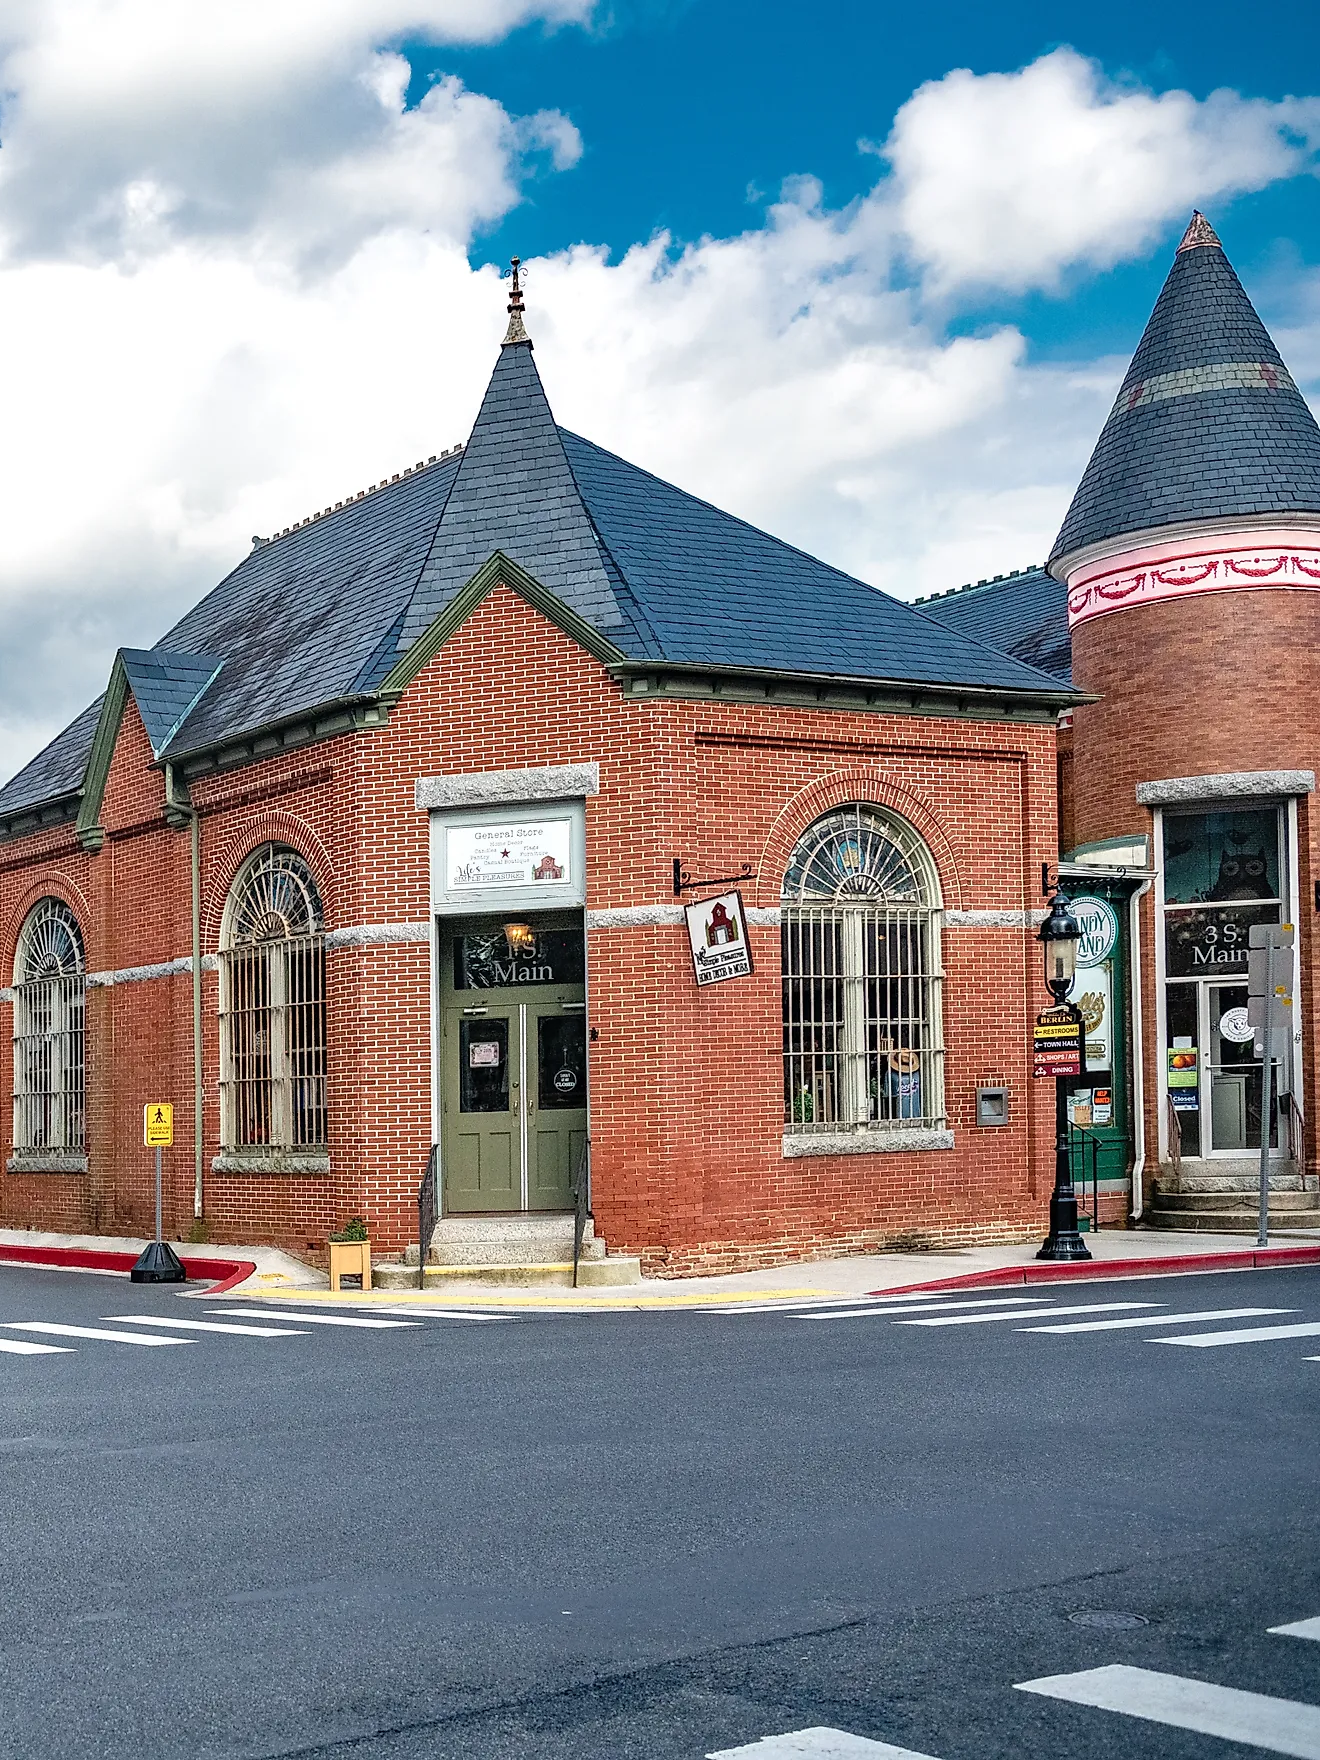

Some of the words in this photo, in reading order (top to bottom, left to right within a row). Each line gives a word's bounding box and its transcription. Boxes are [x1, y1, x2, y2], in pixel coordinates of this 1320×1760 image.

[474, 830, 514, 840] General
[516, 828, 544, 838] Store
[454, 874, 481, 882] SIMPLE
[483, 872, 525, 881] PLEASURES
[1205, 926, 1218, 944] 3
[1223, 924, 1242, 943] S.
[523, 938, 542, 959] S.
[1078, 936, 1104, 957] AND
[1192, 945, 1249, 965] Main
[493, 961, 555, 983] Main
[1040, 1015, 1073, 1024] BERLIN
[1043, 1027, 1078, 1035] RESTROOMS
[1052, 1066, 1074, 1074] DINING
